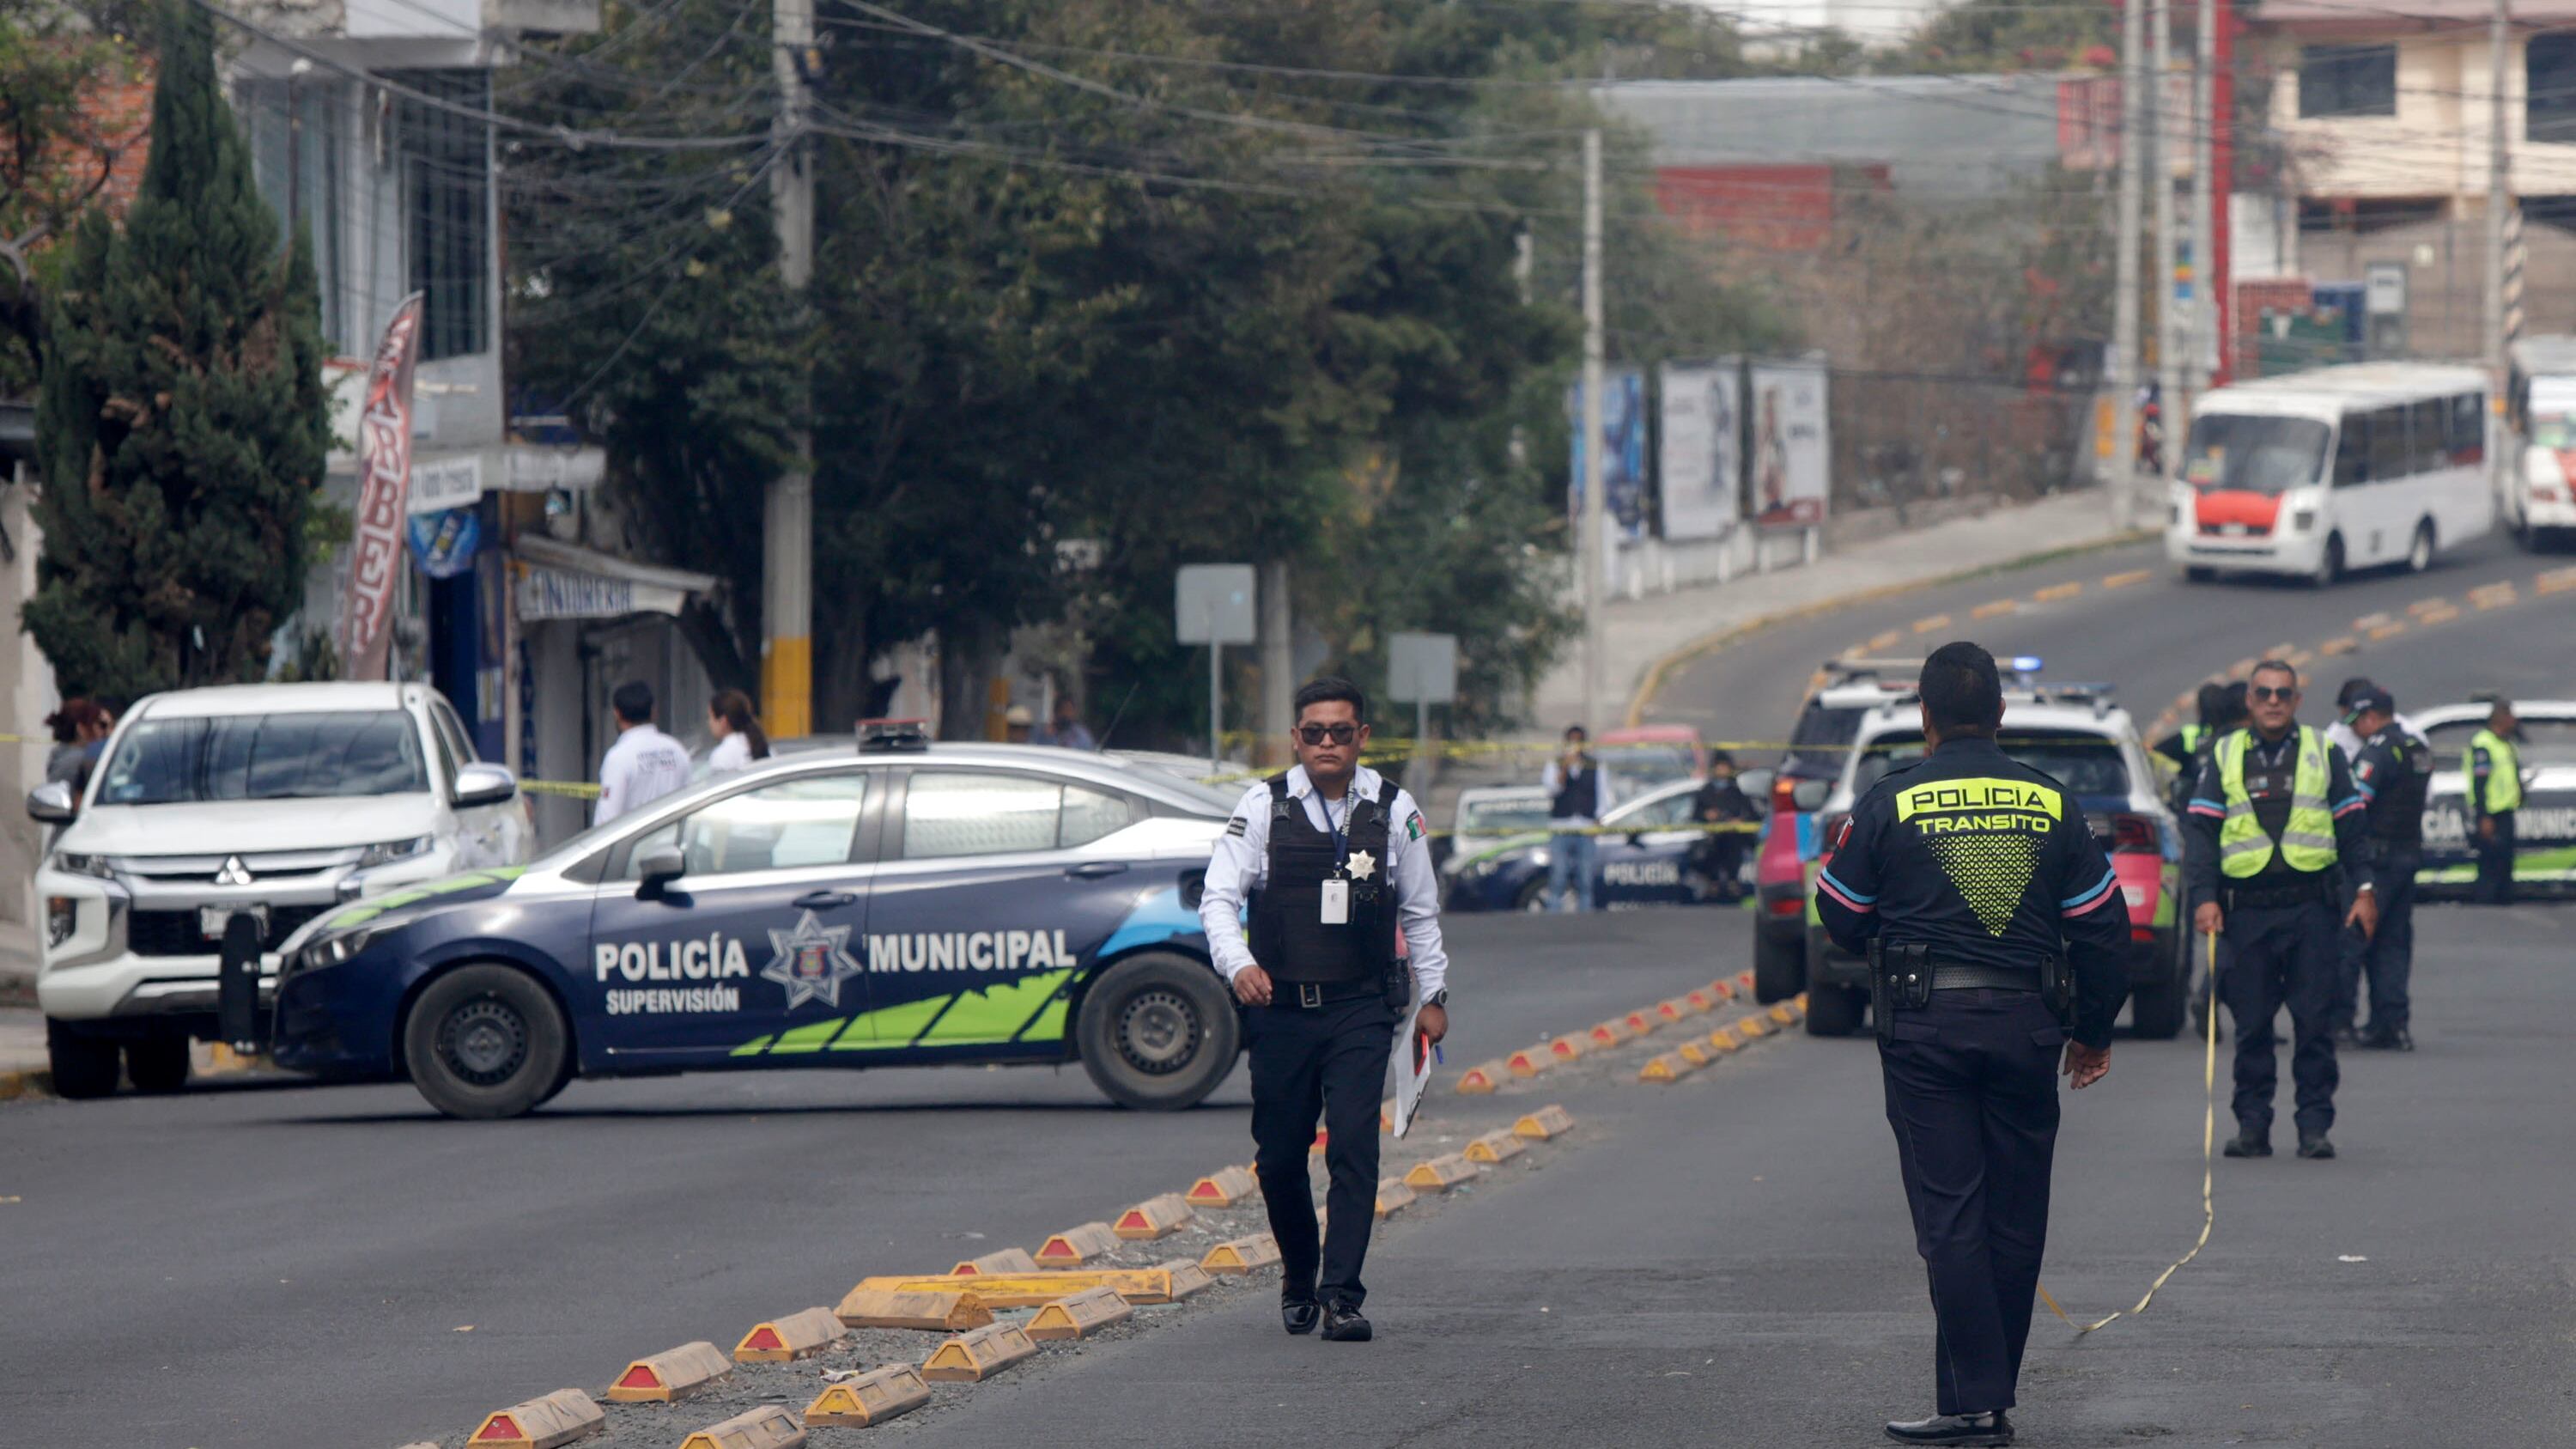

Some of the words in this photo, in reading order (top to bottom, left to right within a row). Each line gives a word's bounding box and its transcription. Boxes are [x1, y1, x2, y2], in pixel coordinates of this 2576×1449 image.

[1915, 814, 2050, 834] TRANSITO
[595, 931, 750, 981] POLICÍA
[868, 930, 1076, 971] MUNICIPAL
[605, 982, 739, 1014] SUPERVISIÓN
